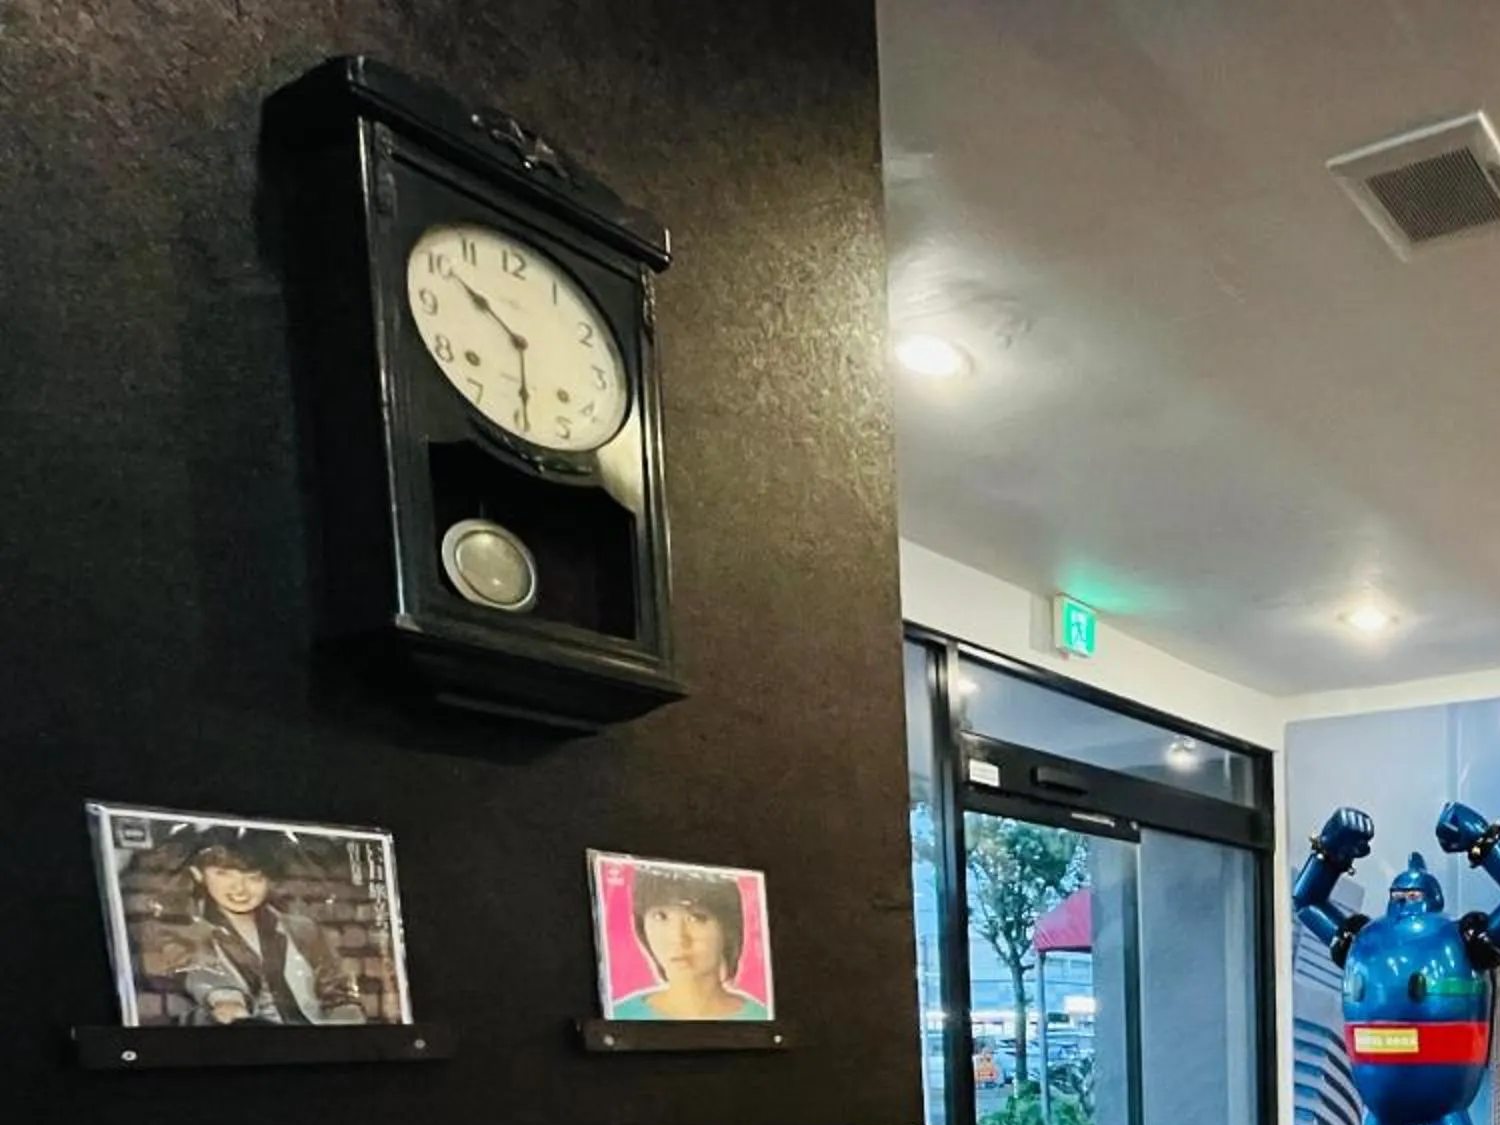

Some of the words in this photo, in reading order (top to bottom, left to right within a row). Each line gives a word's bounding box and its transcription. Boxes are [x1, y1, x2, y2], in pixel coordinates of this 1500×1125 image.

[428, 251, 453, 279] 10
[462, 237, 477, 266] 11
[502, 249, 527, 280] 12
[419, 288, 438, 316] 9
[435, 334, 454, 363] 8
[577, 322, 594, 347] 2
[467, 378, 483, 405] 7
[592, 365, 607, 391] 3
[556, 415, 573, 440] 5
